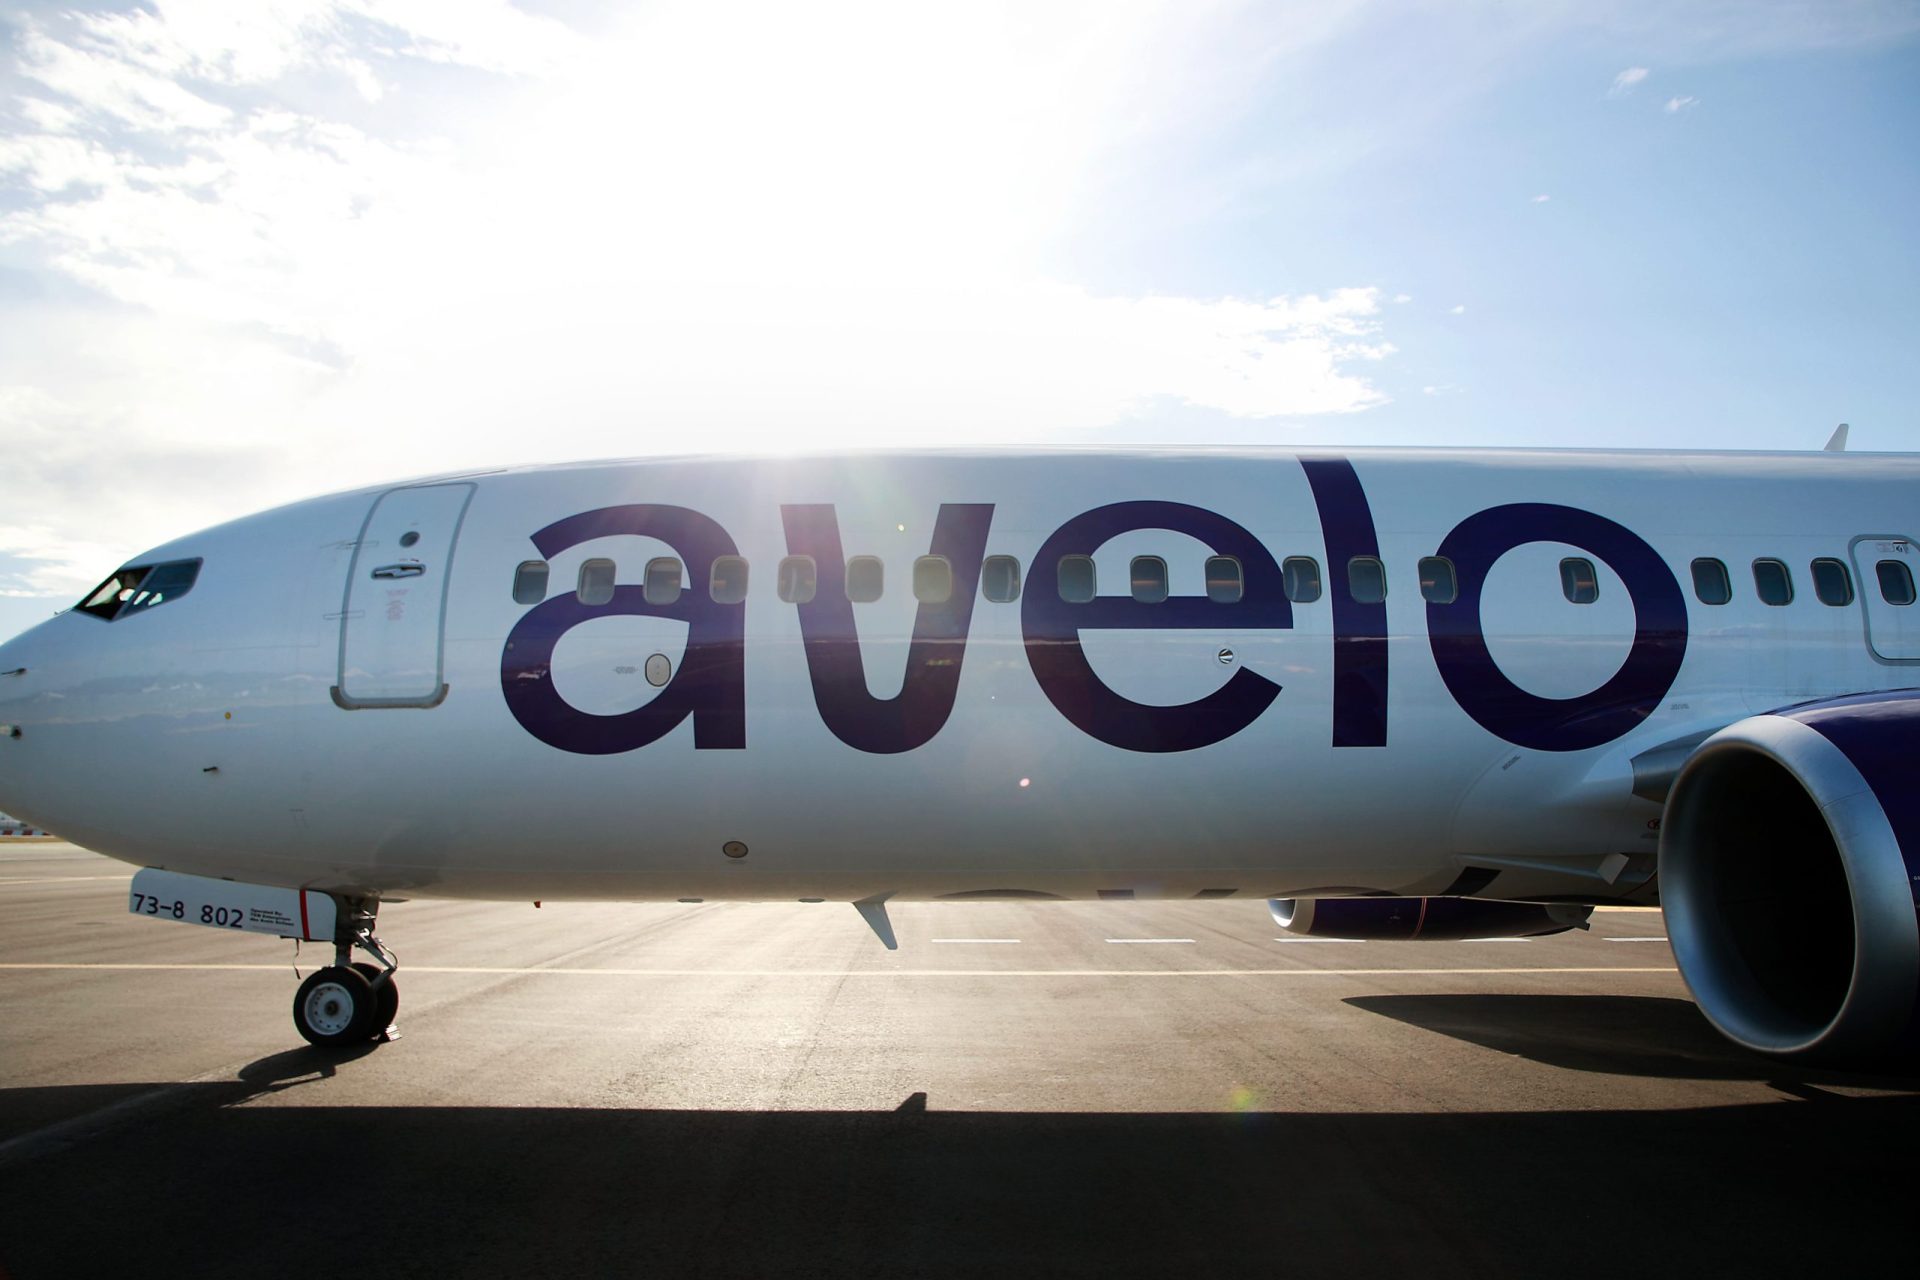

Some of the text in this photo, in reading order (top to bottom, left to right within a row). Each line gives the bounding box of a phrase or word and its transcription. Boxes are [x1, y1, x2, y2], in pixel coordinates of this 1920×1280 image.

[501, 455, 1688, 755] avelo
[132, 893, 244, 929] 73-8 802
